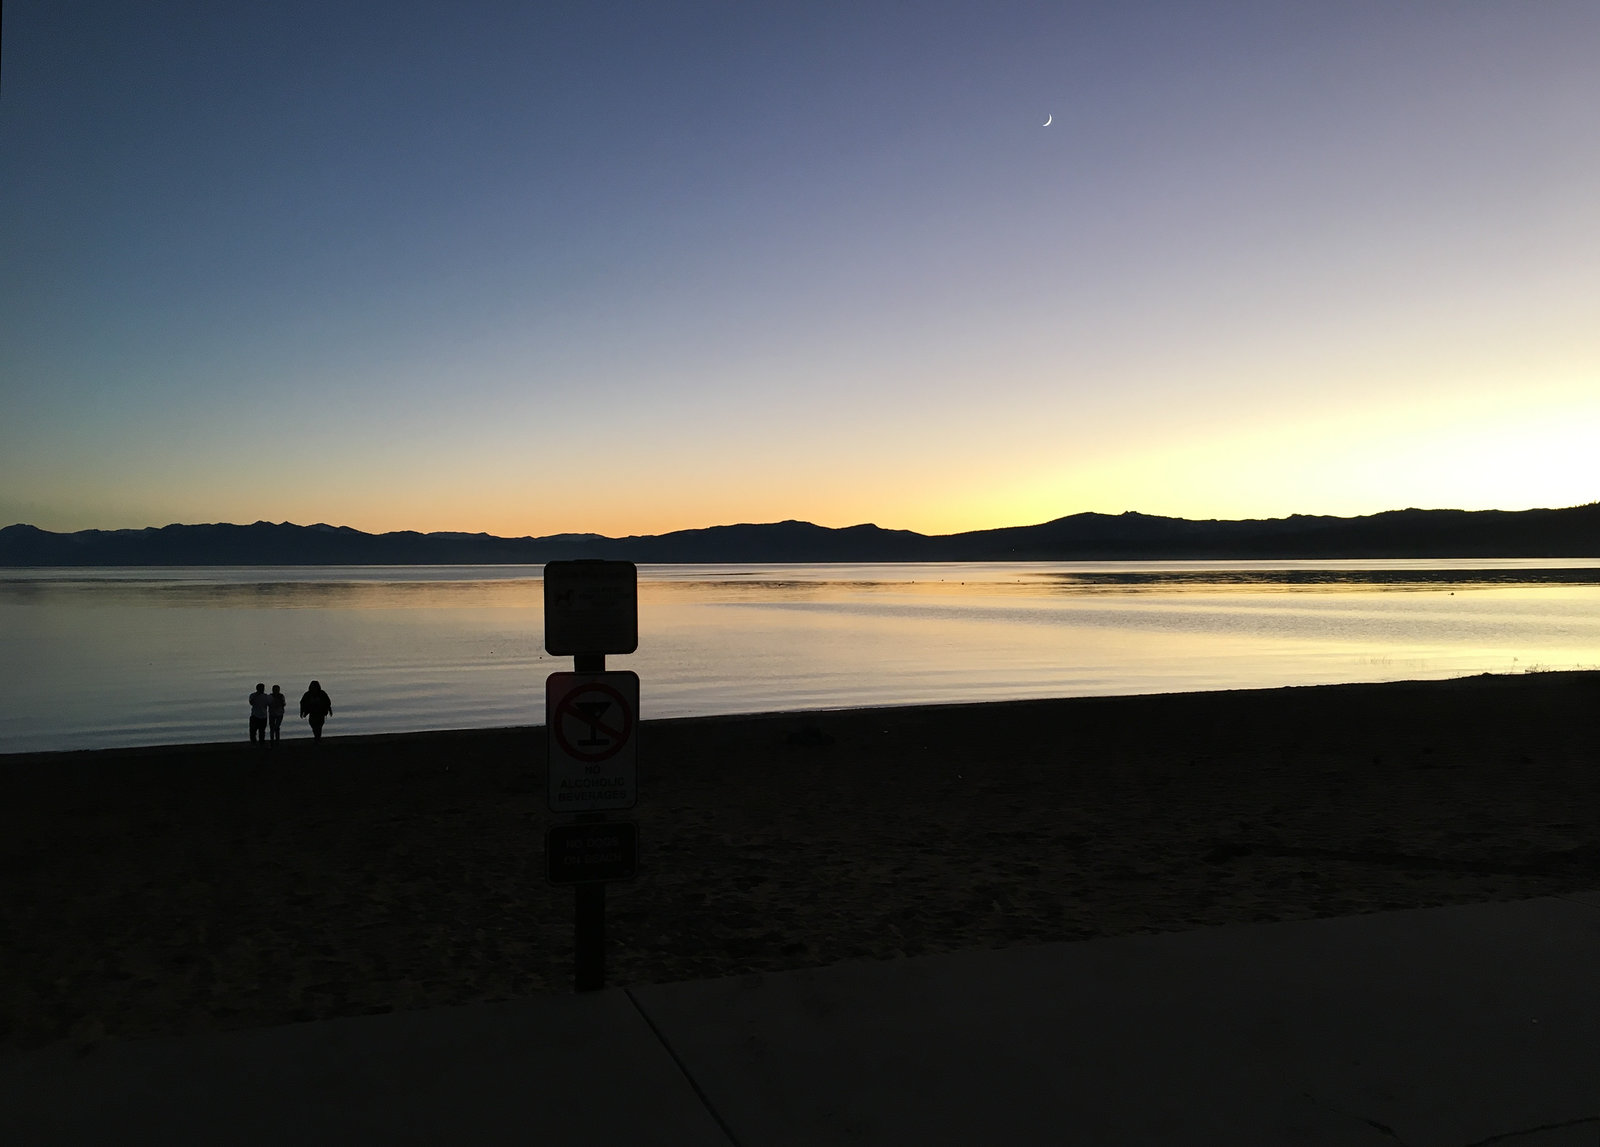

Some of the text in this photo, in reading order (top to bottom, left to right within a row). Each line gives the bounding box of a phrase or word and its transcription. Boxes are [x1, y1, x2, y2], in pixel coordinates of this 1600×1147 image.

[585, 764, 601, 775] NO
[560, 777, 625, 789] ALCOHOLIC
[558, 790, 626, 802] BEVERAGES
